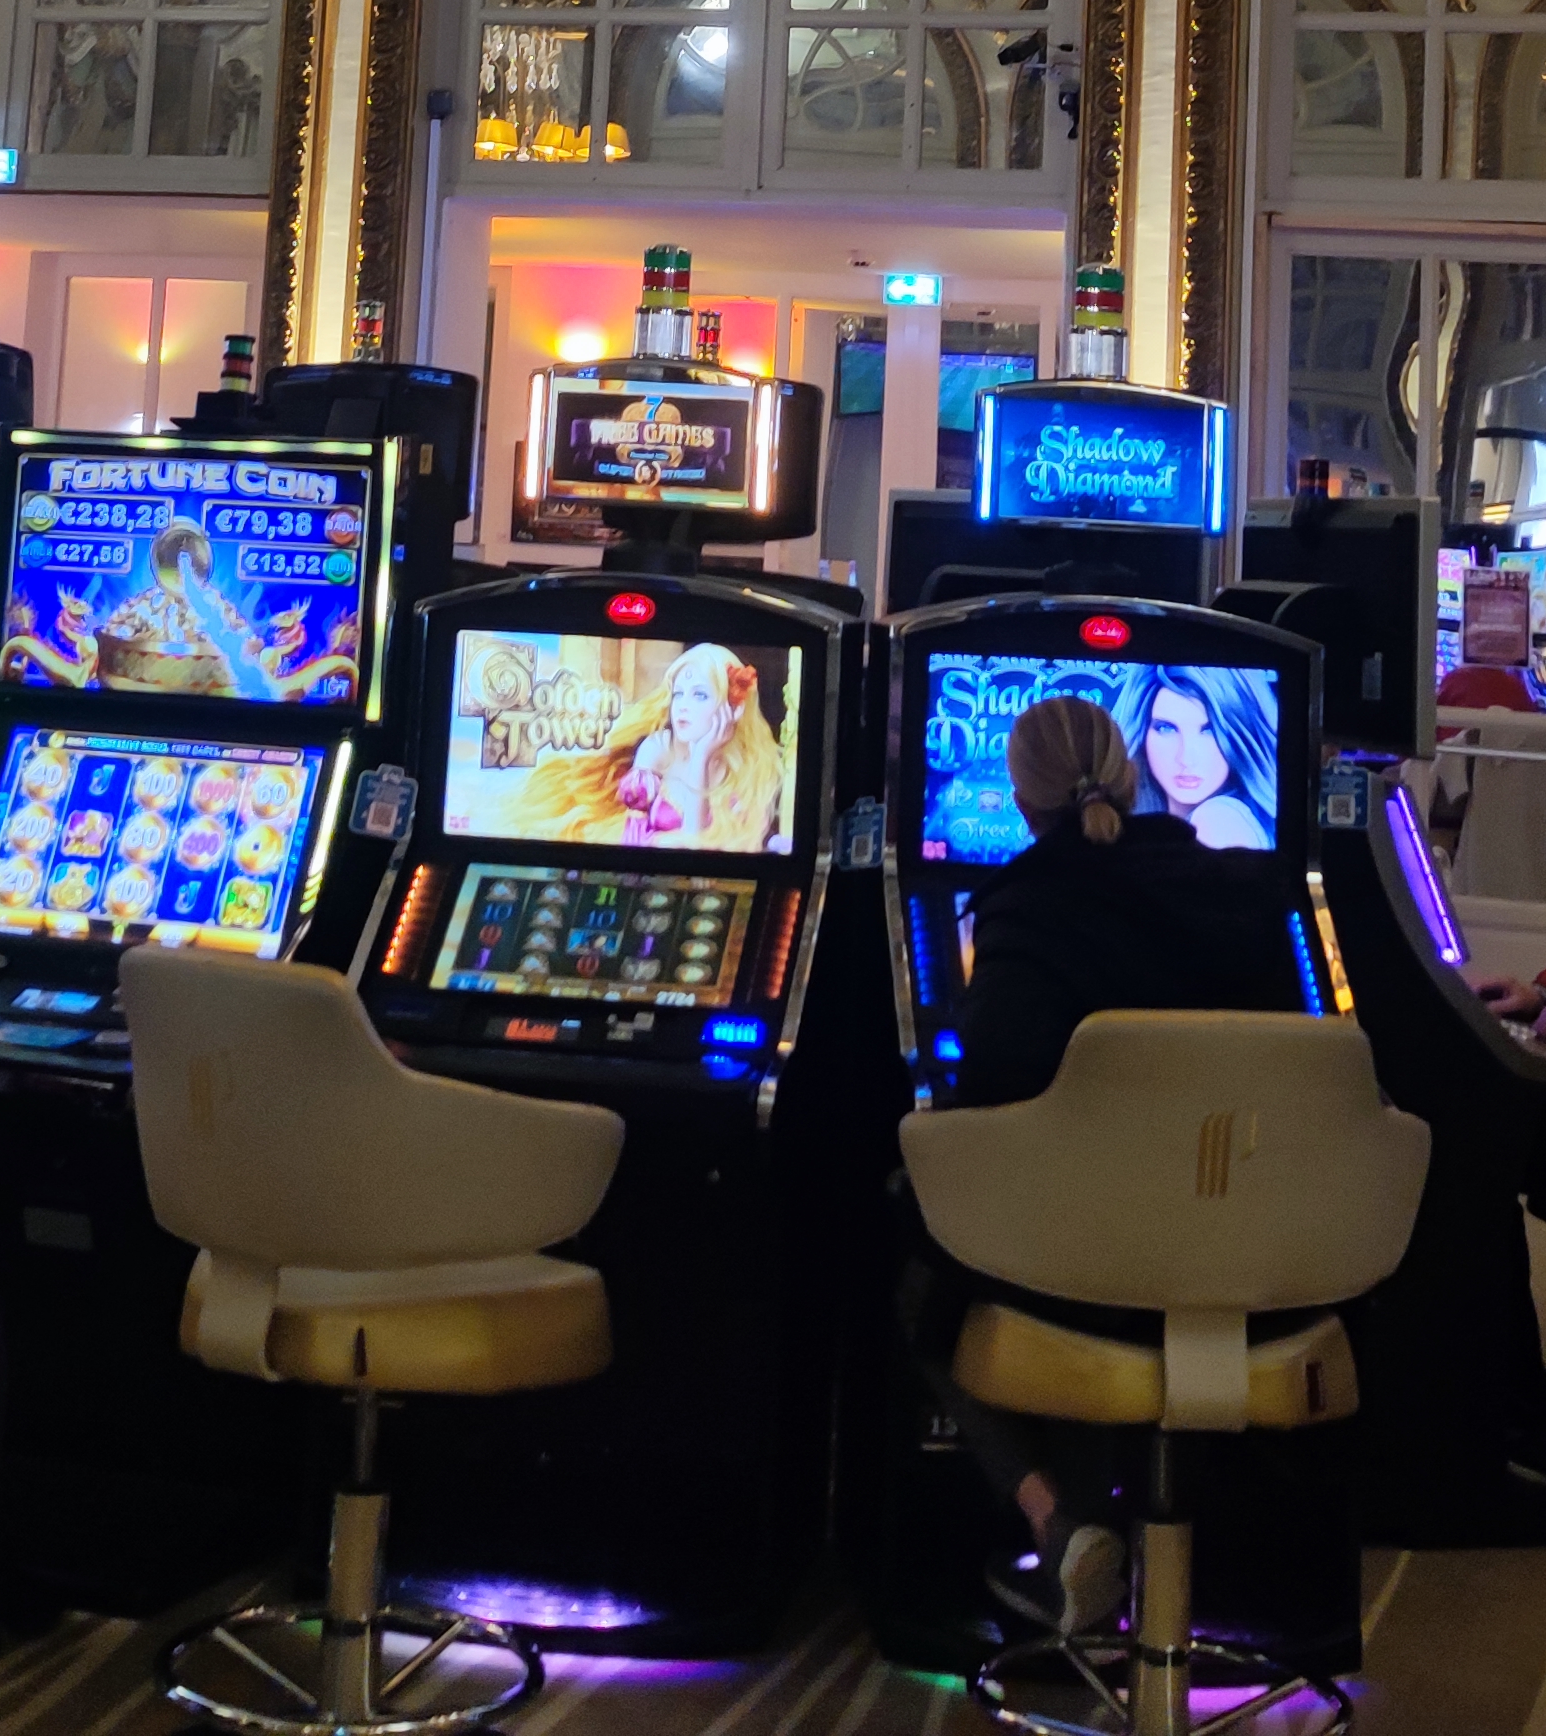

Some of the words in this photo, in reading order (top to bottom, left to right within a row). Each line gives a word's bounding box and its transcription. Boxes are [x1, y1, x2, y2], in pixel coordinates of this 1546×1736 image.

[643, 394, 664, 422] 7
[643, 422, 715, 449] GAMES
[1036, 424, 1166, 466] Shadow
[1025, 459, 1178, 504] Diamond
[59, 500, 170, 534] €238,28
[214, 508, 313, 540] €79,38
[54, 542, 126, 567] €27,56
[244, 552, 321, 577] €13,52
[467, 643, 622, 720] Golden
[498, 709, 613, 769] Tower
[22, 765, 63, 786] 40
[141, 773, 178, 796] 100
[256, 781, 290, 807] 60
[13, 815, 51, 839] 200
[125, 826, 162, 850] 80
[0, 869, 34, 892] 20
[115, 878, 149, 901] 100
